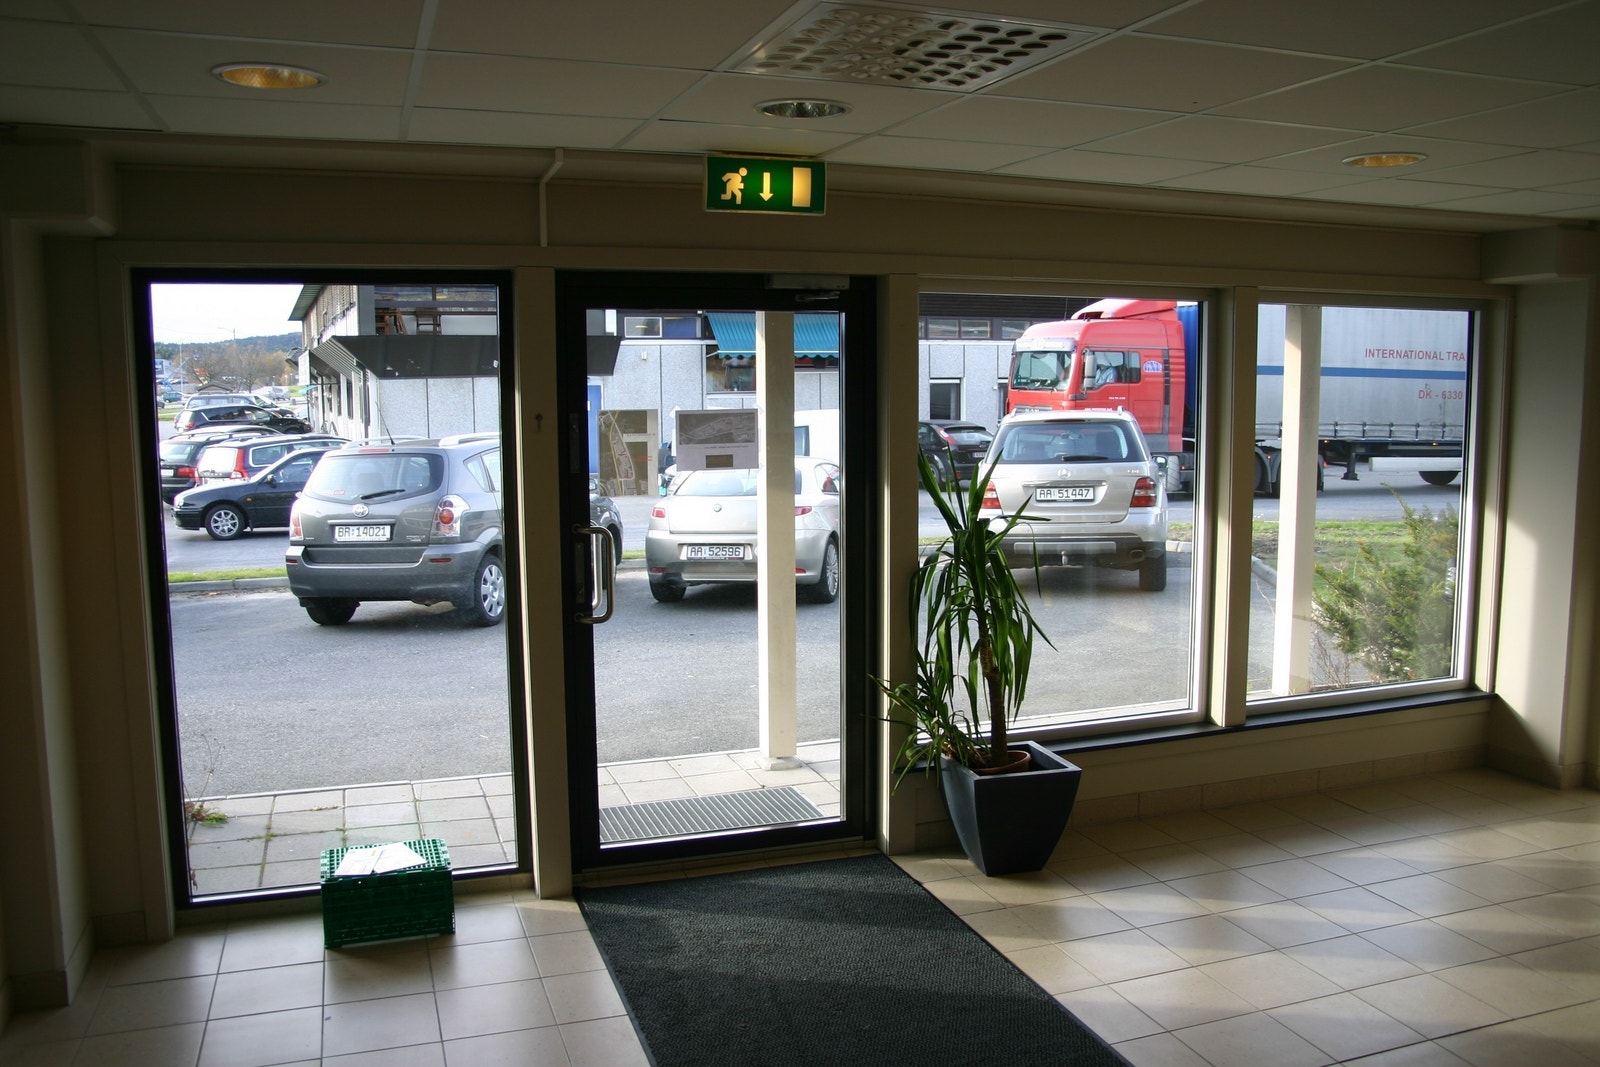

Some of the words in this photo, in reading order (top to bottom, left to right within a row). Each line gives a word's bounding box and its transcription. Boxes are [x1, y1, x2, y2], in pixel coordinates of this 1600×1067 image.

[1364, 348, 1444, 361] INTERNATIONAL
[1446, 351, 1466, 361] TRA
[1418, 389, 1432, 399] DK
[1441, 390, 1463, 400] 6330
[1039, 489, 1052, 499] AA
[1057, 488, 1090, 499] 51447
[355, 526, 387, 537] 14021
[690, 546, 703, 557] AA
[708, 546, 741, 557] 52596
